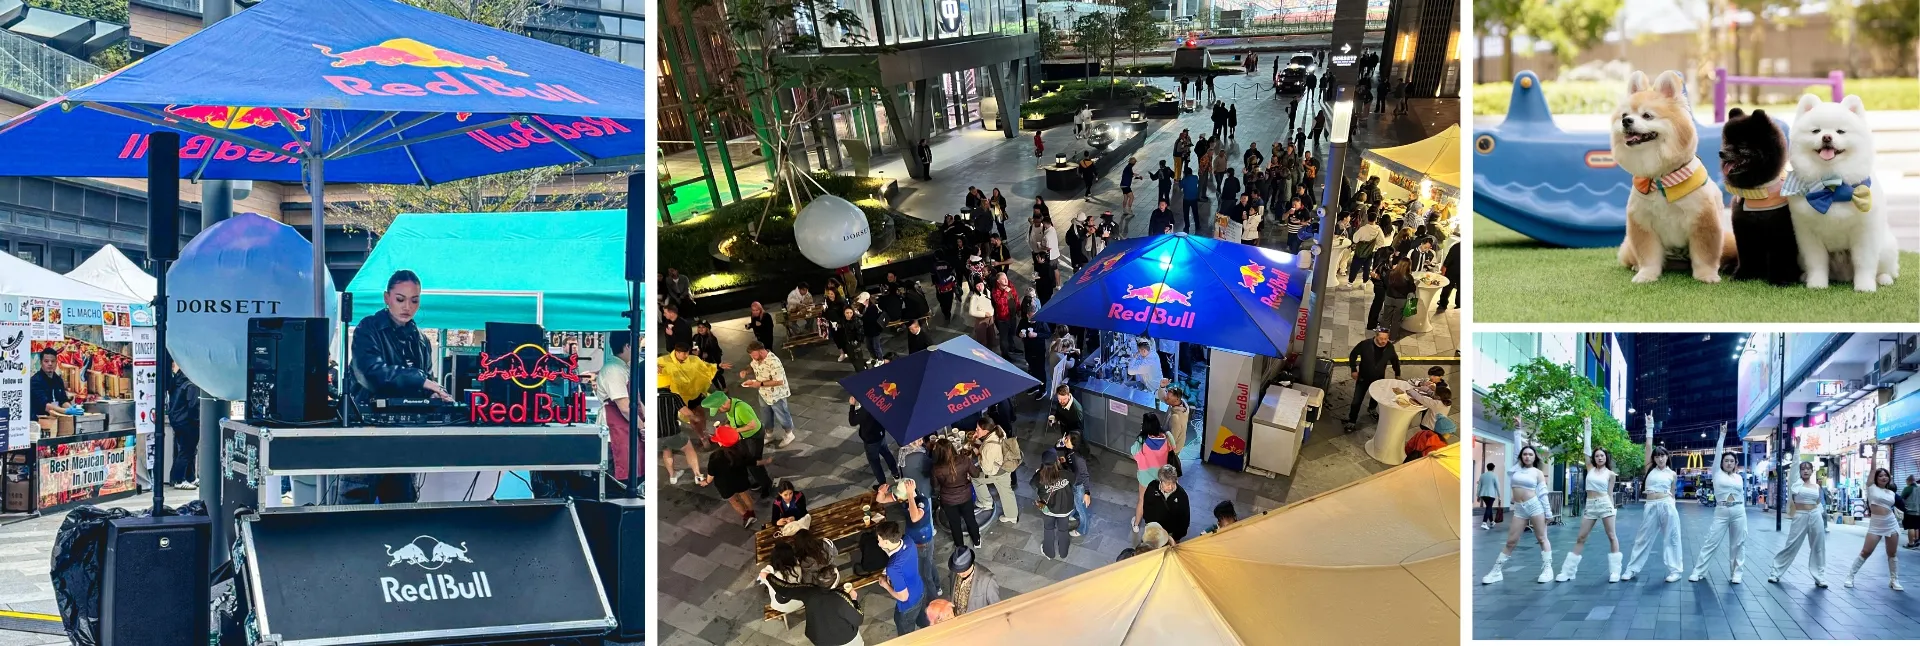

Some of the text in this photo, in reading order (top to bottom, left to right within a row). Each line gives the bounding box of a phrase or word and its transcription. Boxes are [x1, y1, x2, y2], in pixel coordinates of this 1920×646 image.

[322, 72, 599, 105] Red Bull
[4, 302, 13, 313] 10
[67, 307, 101, 318] EL MACHO
[176, 299, 281, 314] DORSETT
[1107, 303, 1196, 329] Red Bull
[1296, 307, 1309, 341] Red Bull
[470, 391, 587, 424] Red Bull
[866, 388, 892, 413] Red Bull
[947, 388, 992, 414] Red Bull
[1235, 383, 1249, 421] Red Bull
[50, 449, 125, 474] Best Mexican Food
[73, 470, 104, 486] In Town
[380, 571, 492, 603] Red Bull
